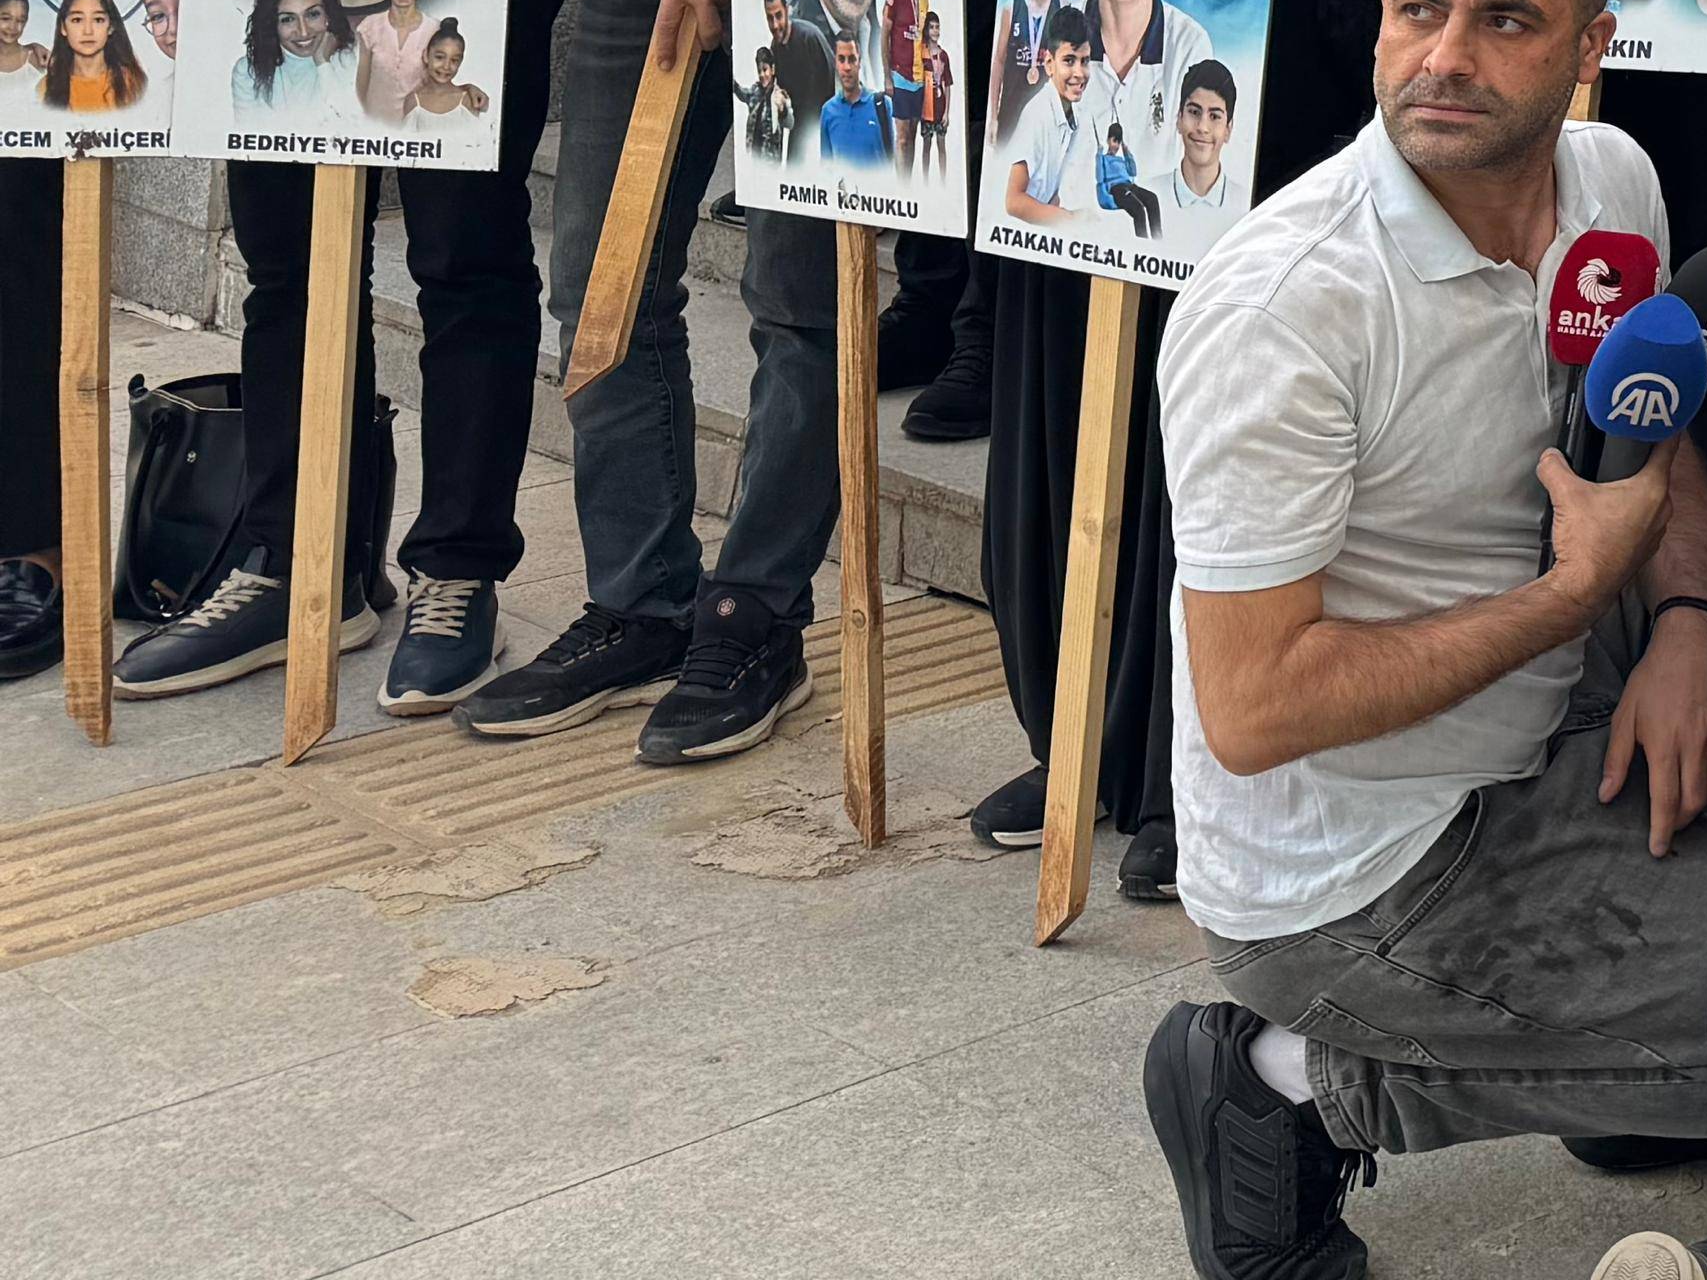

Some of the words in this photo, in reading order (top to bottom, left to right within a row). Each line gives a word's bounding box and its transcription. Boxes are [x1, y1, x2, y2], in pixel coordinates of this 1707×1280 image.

[1013, 23, 1020, 37] 5
[228, 132, 327, 154] BEDRİYE
[336, 137, 442, 160] YENİÇERİ
[779, 183, 828, 206] PAMİR
[990, 226, 1063, 256] ATAKAN
[1070, 240, 1128, 270] CELAL
[1607, 388, 1674, 427] AA
